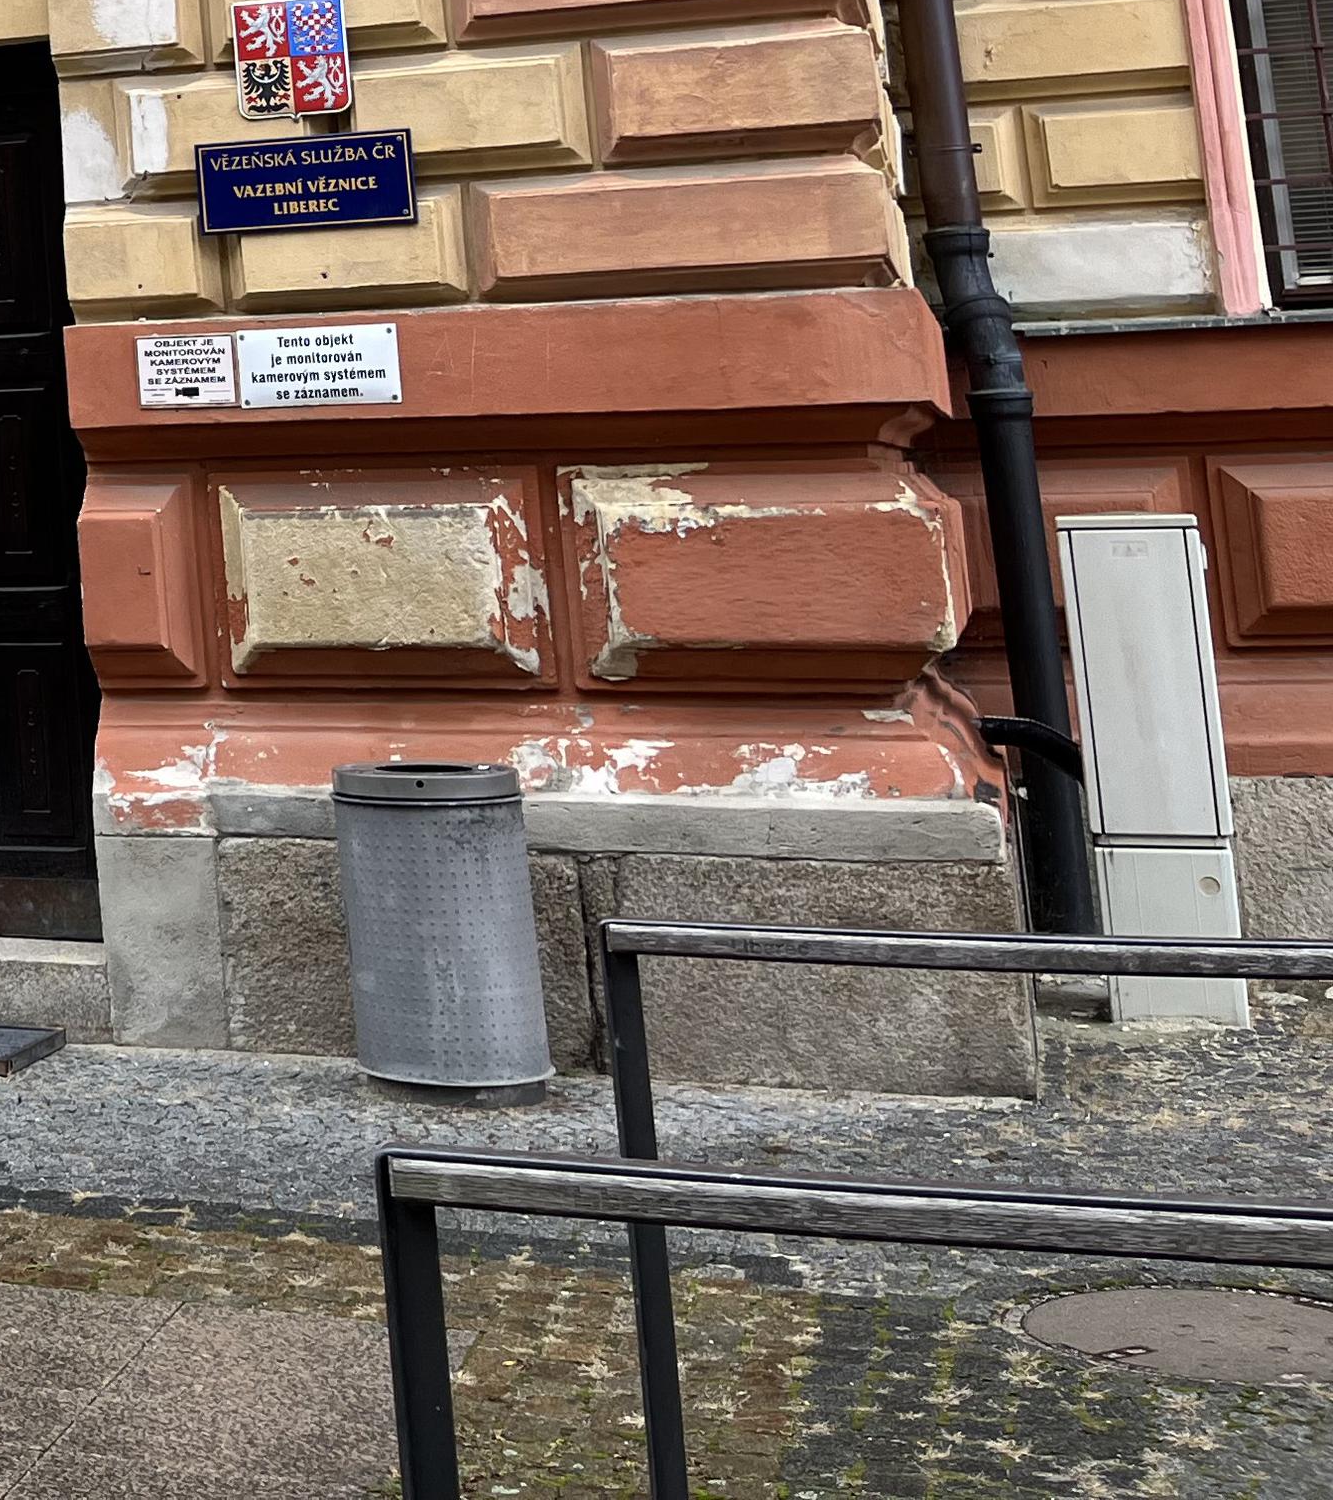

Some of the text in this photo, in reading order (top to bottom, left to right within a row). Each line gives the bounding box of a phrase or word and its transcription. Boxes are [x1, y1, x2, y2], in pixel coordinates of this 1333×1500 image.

[210, 142, 396, 172] VĚZEŇSKÁ SLUŽBA ČR
[233, 176, 378, 199] VAZEBNÍ VĚZNICE
[273, 198, 340, 215] LIBEREC
[154, 339, 197, 348] OBJEKT
[277, 333, 354, 348] Tento objekt
[144, 347, 225, 357] MONITOROVÁN
[271, 350, 363, 368] je monitorován
[150, 357, 221, 366] KAMEROVÝM
[156, 366, 216, 375] SYSTÉMEM
[251, 367, 386, 384] kamerovým systémem
[165, 376, 226, 385] ZÁZNAMEM
[276, 385, 364, 400] se záznamem.
